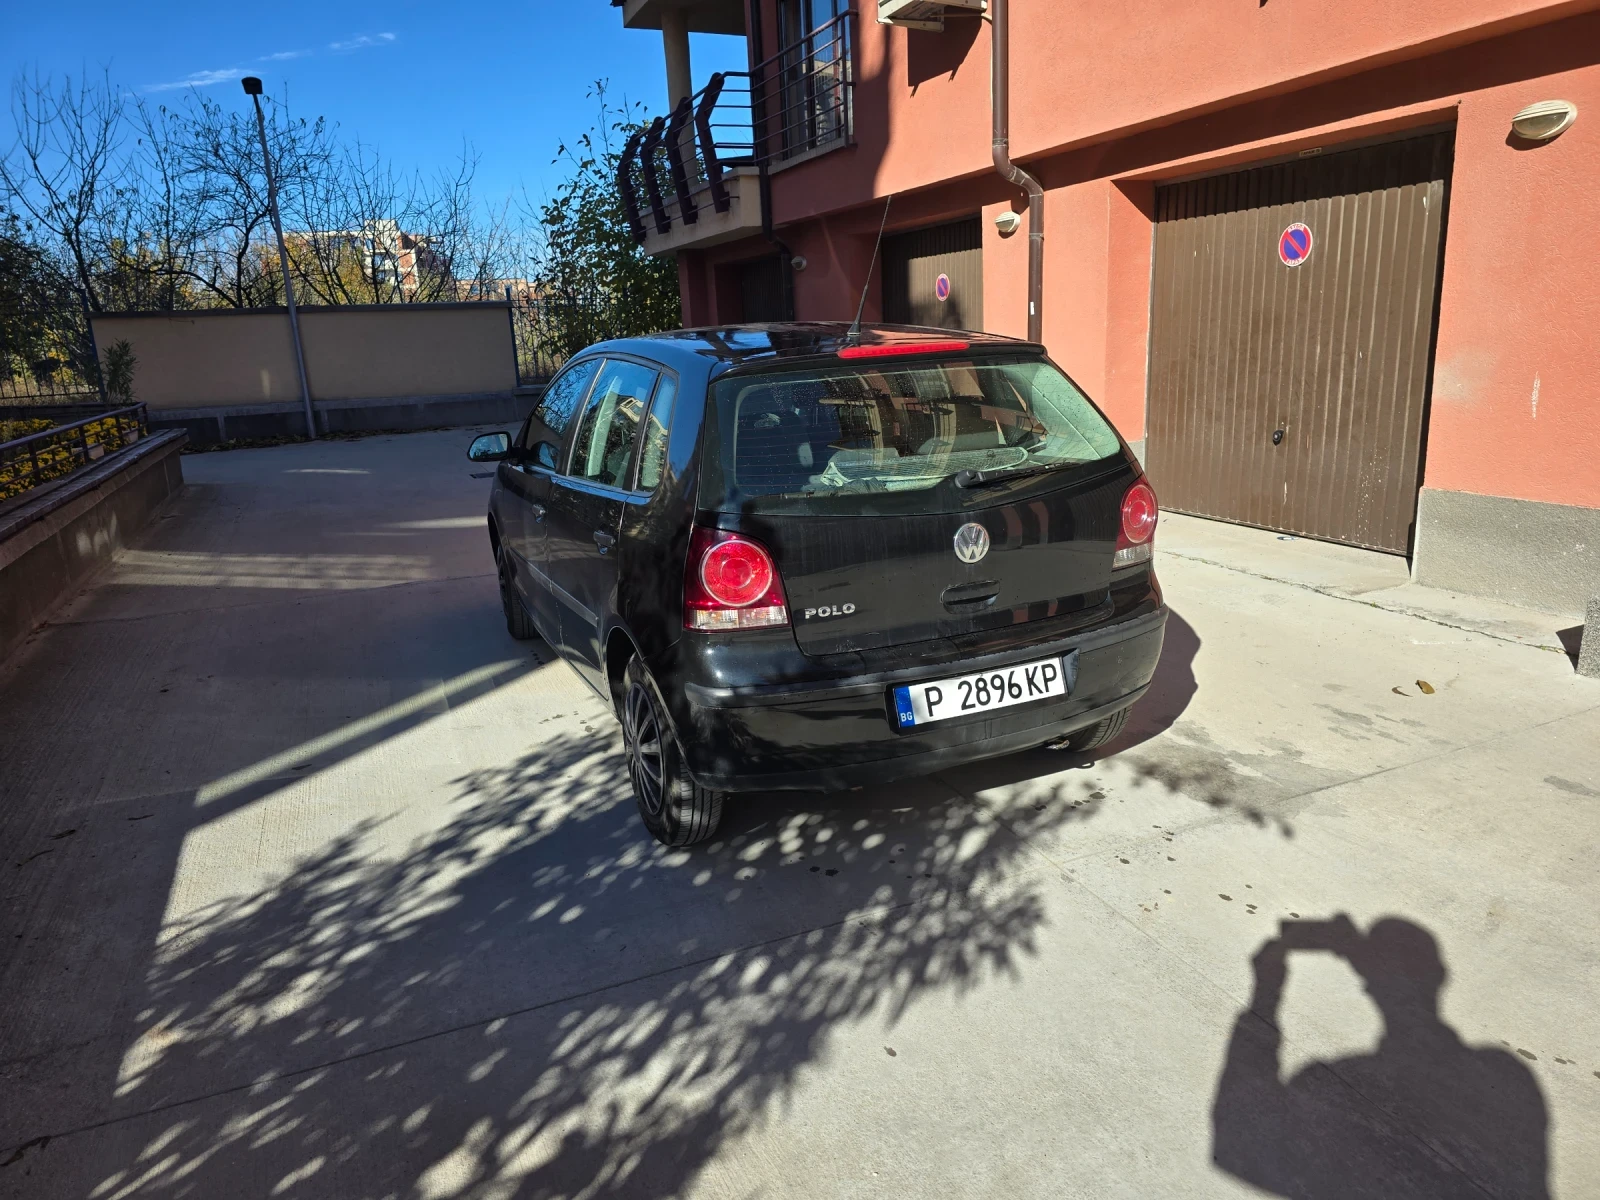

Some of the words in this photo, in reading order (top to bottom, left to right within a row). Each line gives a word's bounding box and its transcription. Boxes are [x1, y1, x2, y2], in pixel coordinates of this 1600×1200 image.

[954, 523, 990, 563] VW
[804, 602, 856, 619] POLO
[924, 686, 943, 717] P
[900, 712, 913, 722] BG
